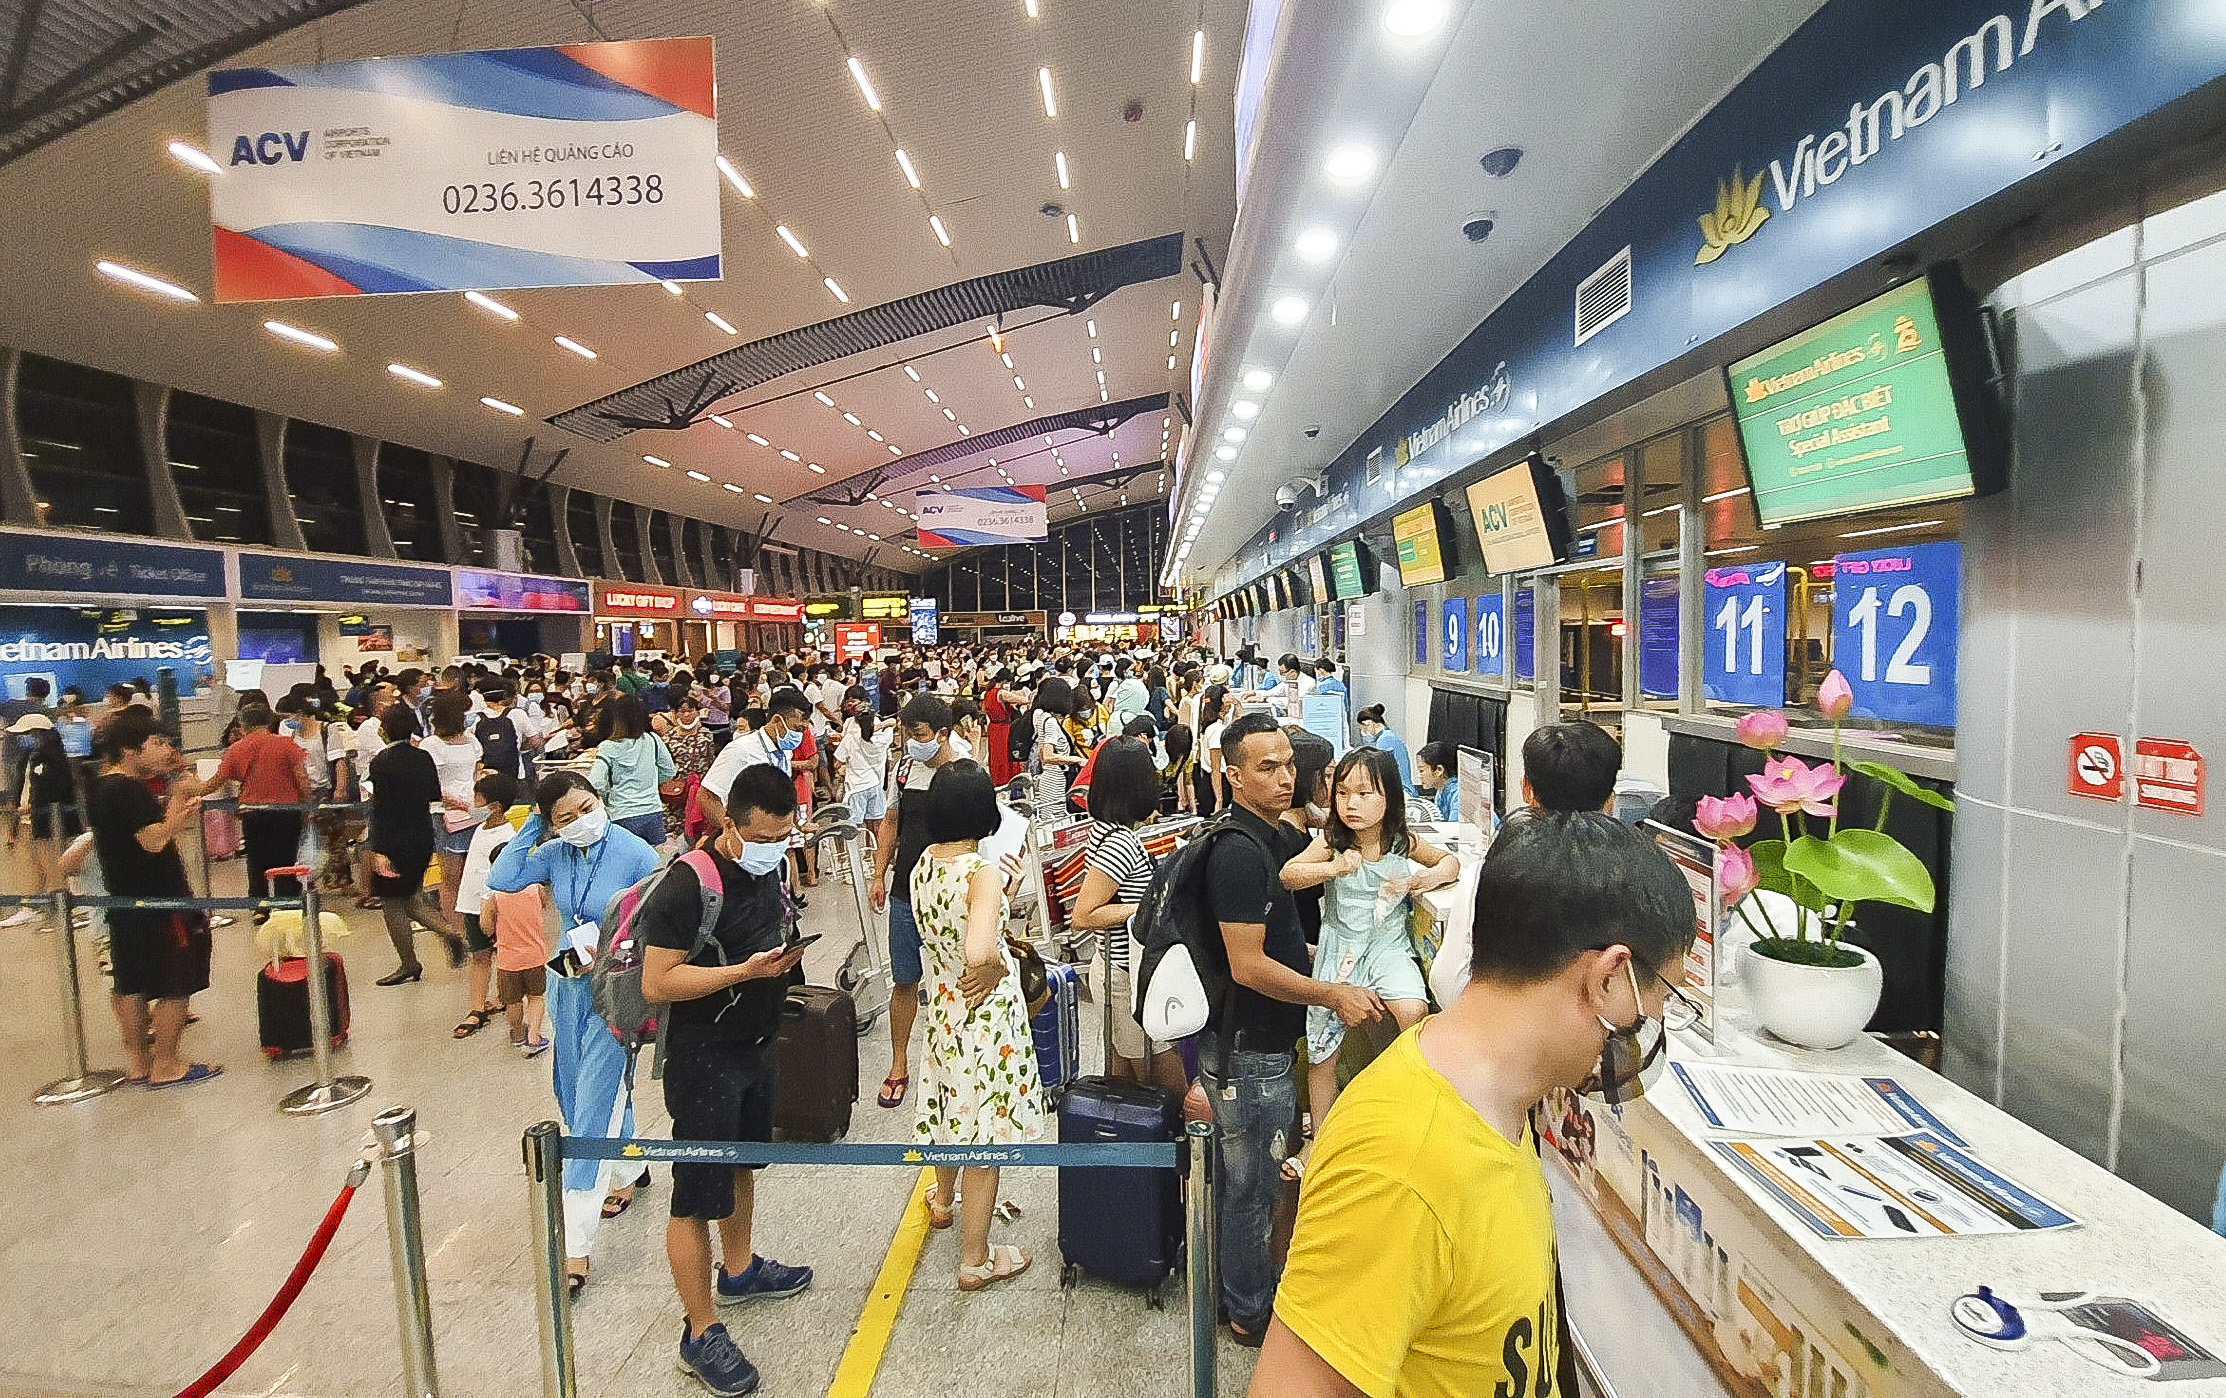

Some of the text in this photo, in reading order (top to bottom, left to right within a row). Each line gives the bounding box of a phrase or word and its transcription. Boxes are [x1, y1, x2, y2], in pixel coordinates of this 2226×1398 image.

[1769, 13, 2013, 212] Vietnam
[230, 131, 310, 167] ACV
[487, 147, 518, 166] LIÊN
[544, 142, 599, 163] QUẢNG
[601, 141, 634, 159] CÁO
[442, 174, 664, 214] 0236.3614338
[923, 506, 944, 514] ACV
[1482, 502, 1508, 533] ACV
[1449, 613, 1459, 655] 9
[1479, 611, 1500, 658] 10
[1715, 595, 1764, 675] 11
[1848, 584, 1933, 686] 12
[923, 1149, 1009, 1162] Vietnam Airlines
